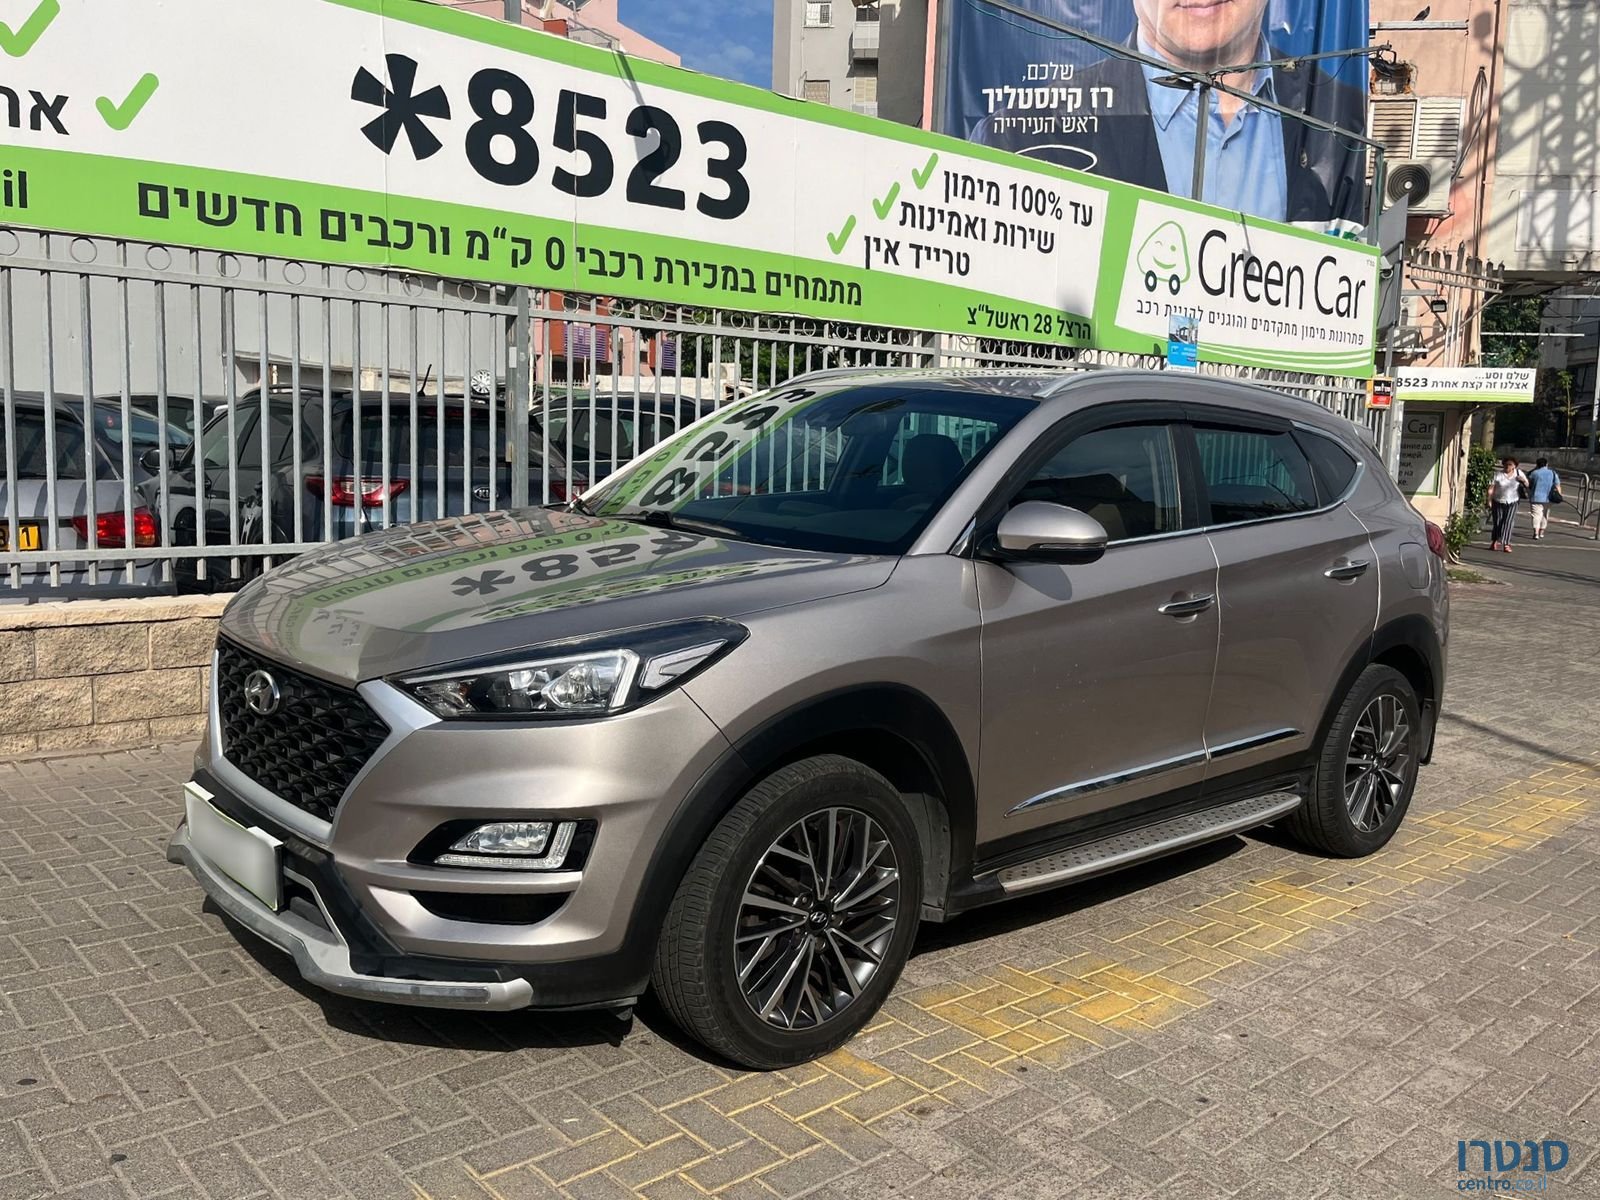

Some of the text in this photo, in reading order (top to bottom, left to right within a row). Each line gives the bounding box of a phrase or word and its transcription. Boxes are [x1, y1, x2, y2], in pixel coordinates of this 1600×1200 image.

[1021, 61, 1074, 82] שלכם,
[982, 84, 1114, 113] רז קינסטליך
[993, 116, 1098, 134] ראש העירייה
[137, 182, 303, 236] חדשים
[944, 170, 1093, 227] עד 100% מימון
[320, 208, 450, 255] ורכבים
[899, 201, 1055, 254] שירות ואמינות
[545, 236, 565, 270] 0
[576, 246, 643, 281] רכבי
[864, 235, 970, 276] טרייד אין
[653, 256, 757, 294] במכירת
[1198, 228, 1366, 320] Green Car
[765, 270, 863, 306] מתמחים
[1136, 299, 1159, 316] רכב
[1033, 313, 1052, 334] 28
[1056, 315, 1092, 340] הרצל
[1208, 310, 1247, 329] והוגנים
[1251, 317, 1298, 337] מתקדמים
[1301, 324, 1326, 341] מימון
[1328, 329, 1364, 346] פתרונות
[1431, 380, 1458, 389] אחרת
[1461, 380, 1483, 391] קצת
[1485, 380, 1498, 390] זה
[1500, 380, 1529, 390] אצלנו
[1506, 371, 1530, 380] שלם
[1407, 418, 1435, 434] Car
